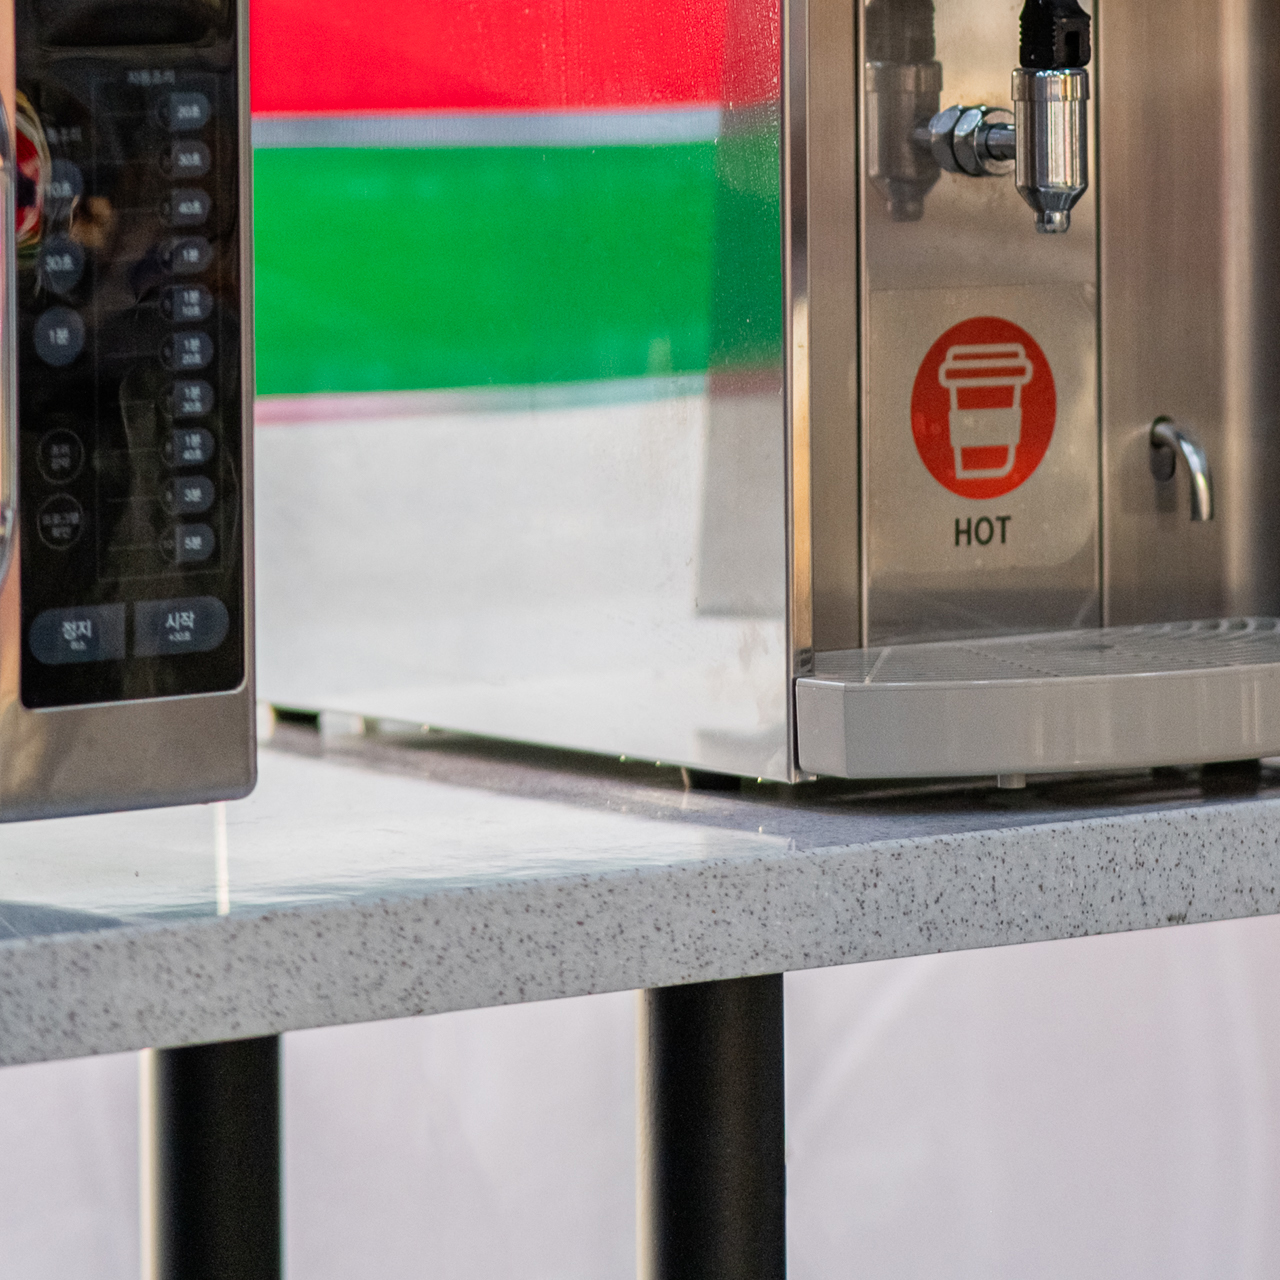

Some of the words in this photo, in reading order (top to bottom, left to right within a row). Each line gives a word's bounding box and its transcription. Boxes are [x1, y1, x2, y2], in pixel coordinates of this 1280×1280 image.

[46, 253, 74, 272] 30초
[49, 327, 69, 346] 1분
[954, 515, 1012, 547] HOT
[61, 619, 92, 640] 정지
[165, 611, 195, 630] 시작
